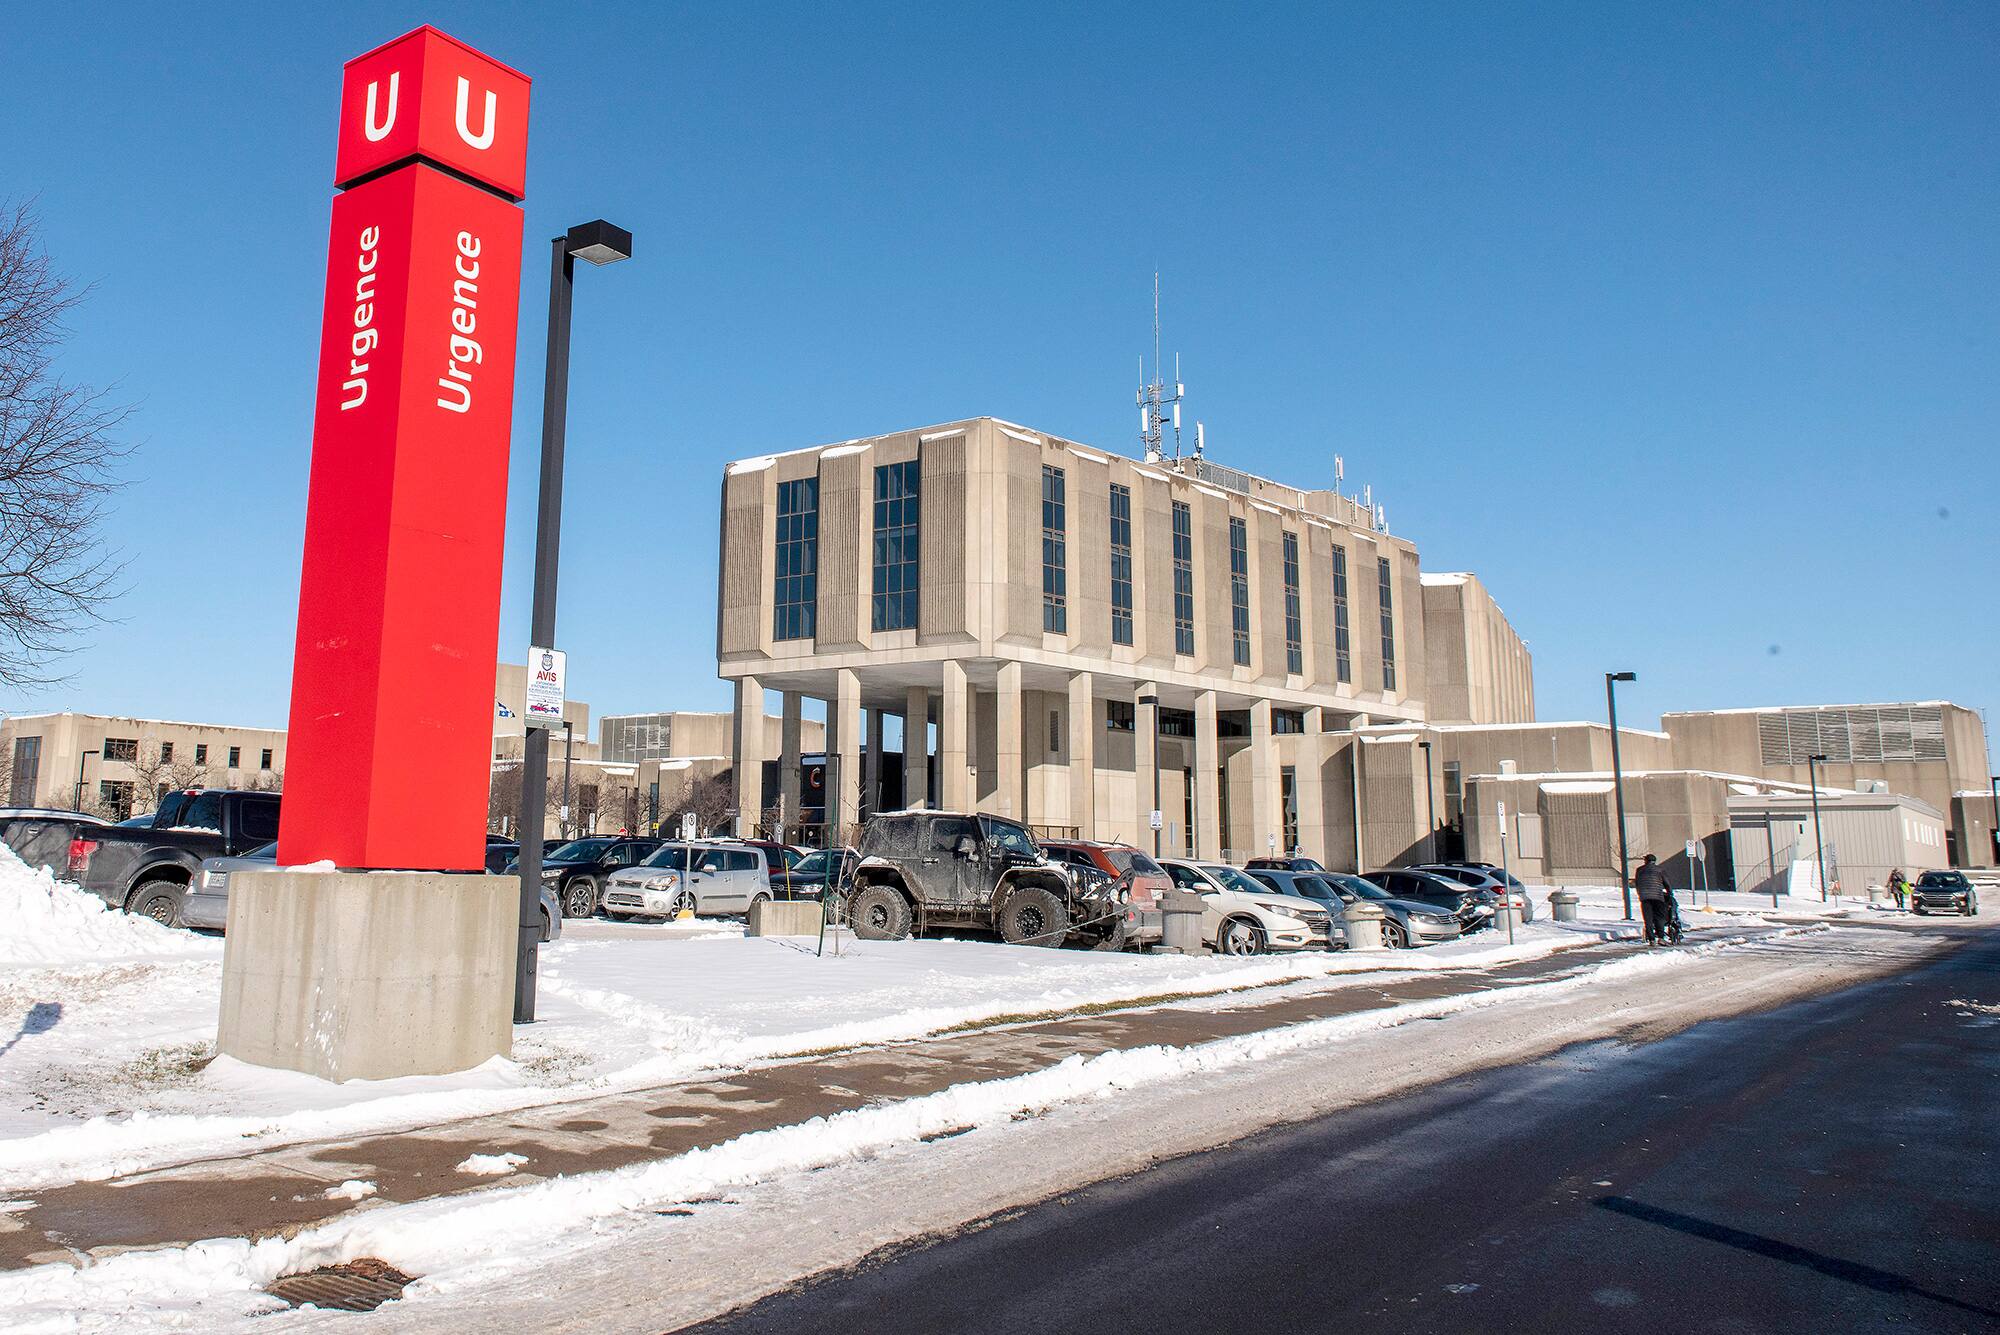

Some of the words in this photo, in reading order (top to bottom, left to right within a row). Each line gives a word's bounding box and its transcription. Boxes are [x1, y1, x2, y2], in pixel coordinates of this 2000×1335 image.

[364, 71, 400, 142] U
[455, 75, 497, 150] U
[341, 225, 380, 411] Urgence
[437, 230, 483, 414] Urgence
[536, 670, 557, 682] AVIS
